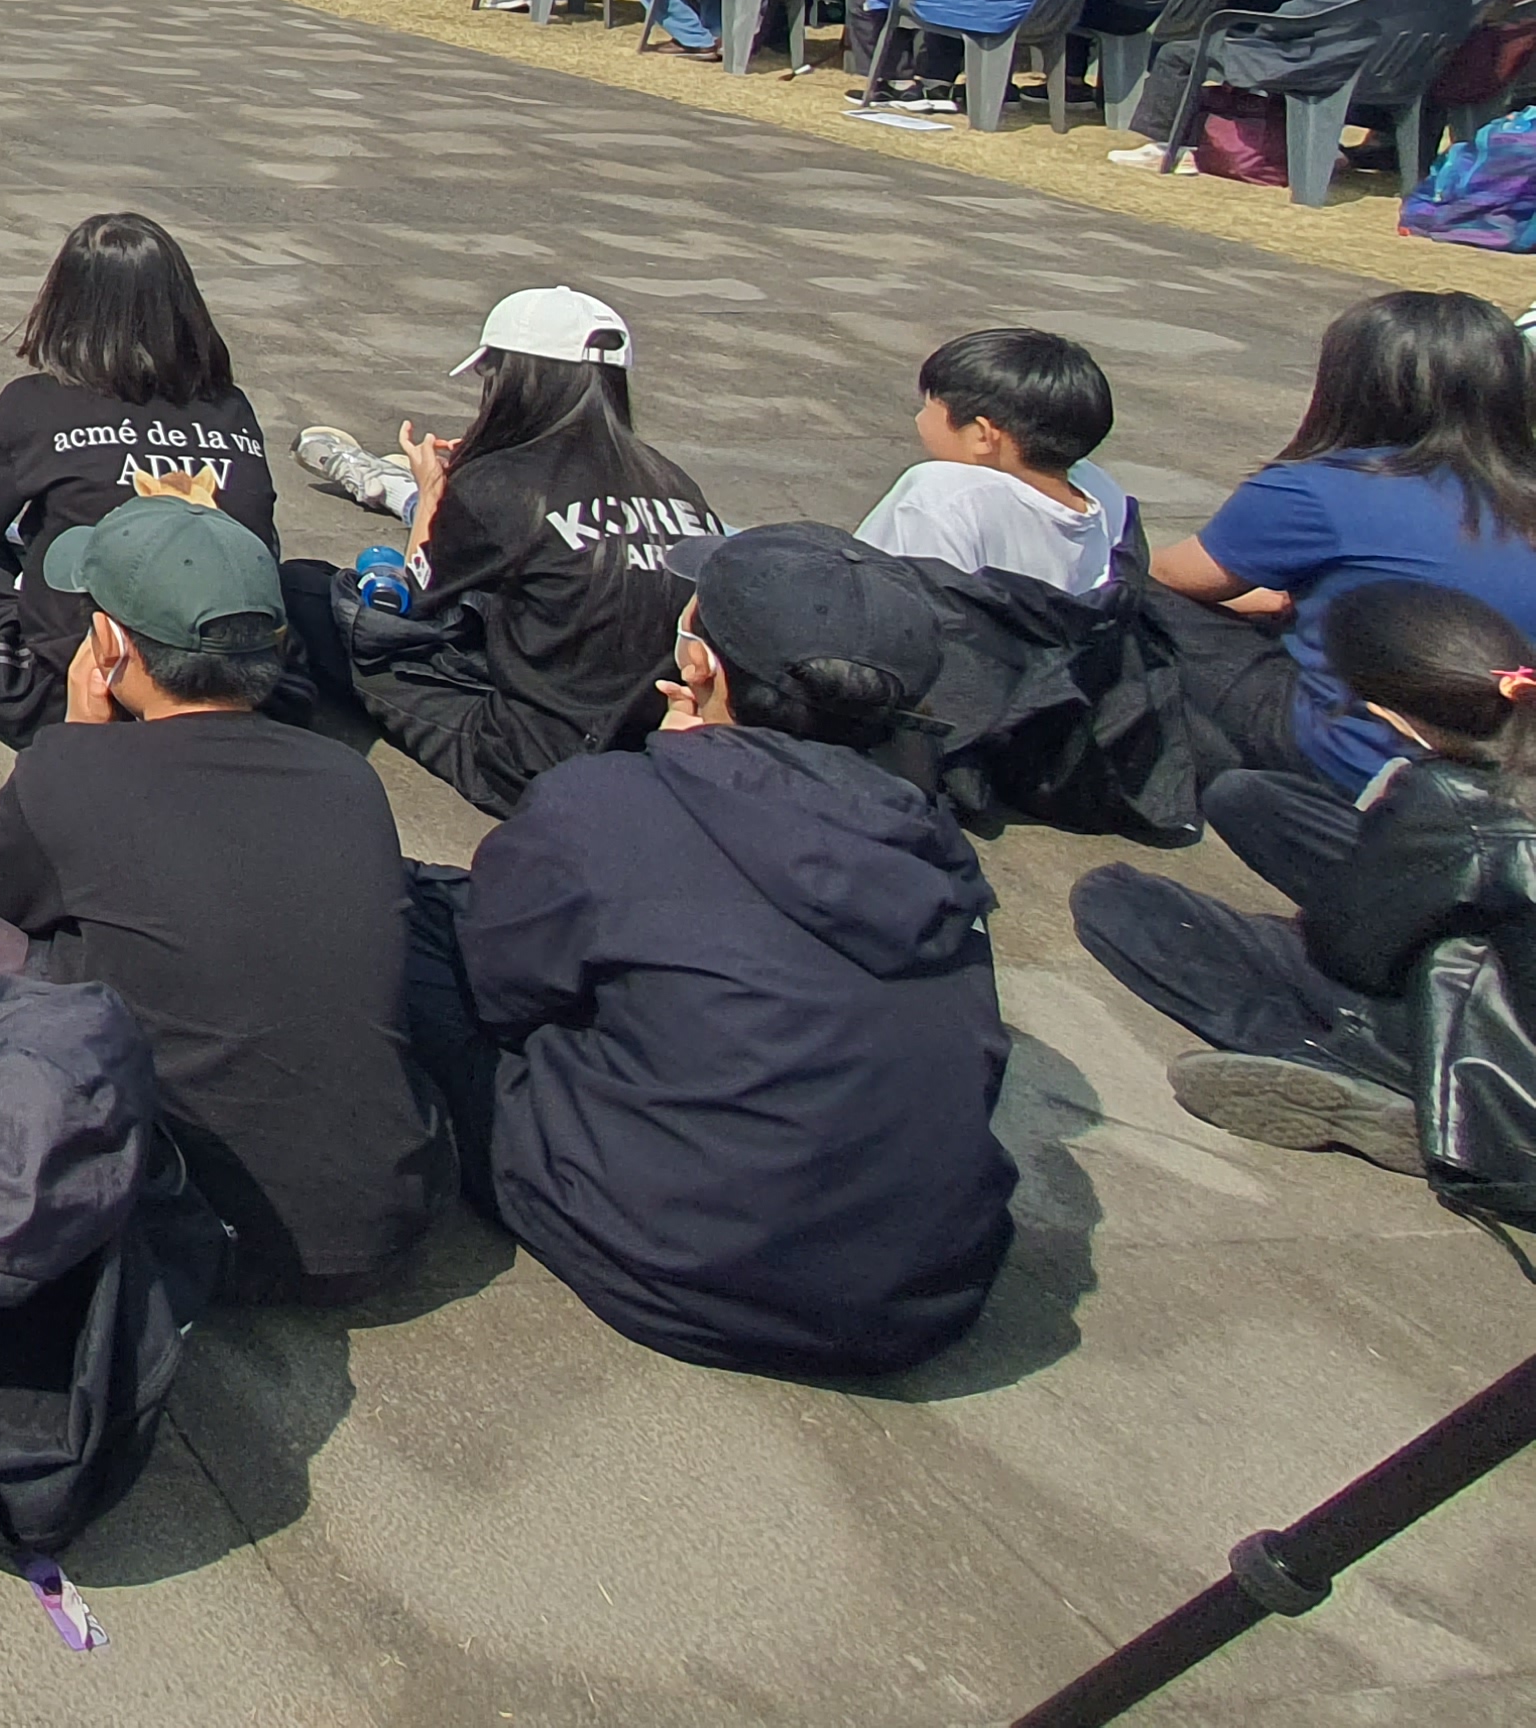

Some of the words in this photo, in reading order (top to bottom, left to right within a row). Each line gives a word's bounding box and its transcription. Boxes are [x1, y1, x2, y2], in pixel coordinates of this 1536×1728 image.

[54, 418, 138, 452] acmé
[148, 421, 187, 448] de
[192, 422, 230, 450] la
[230, 427, 264, 458] vie
